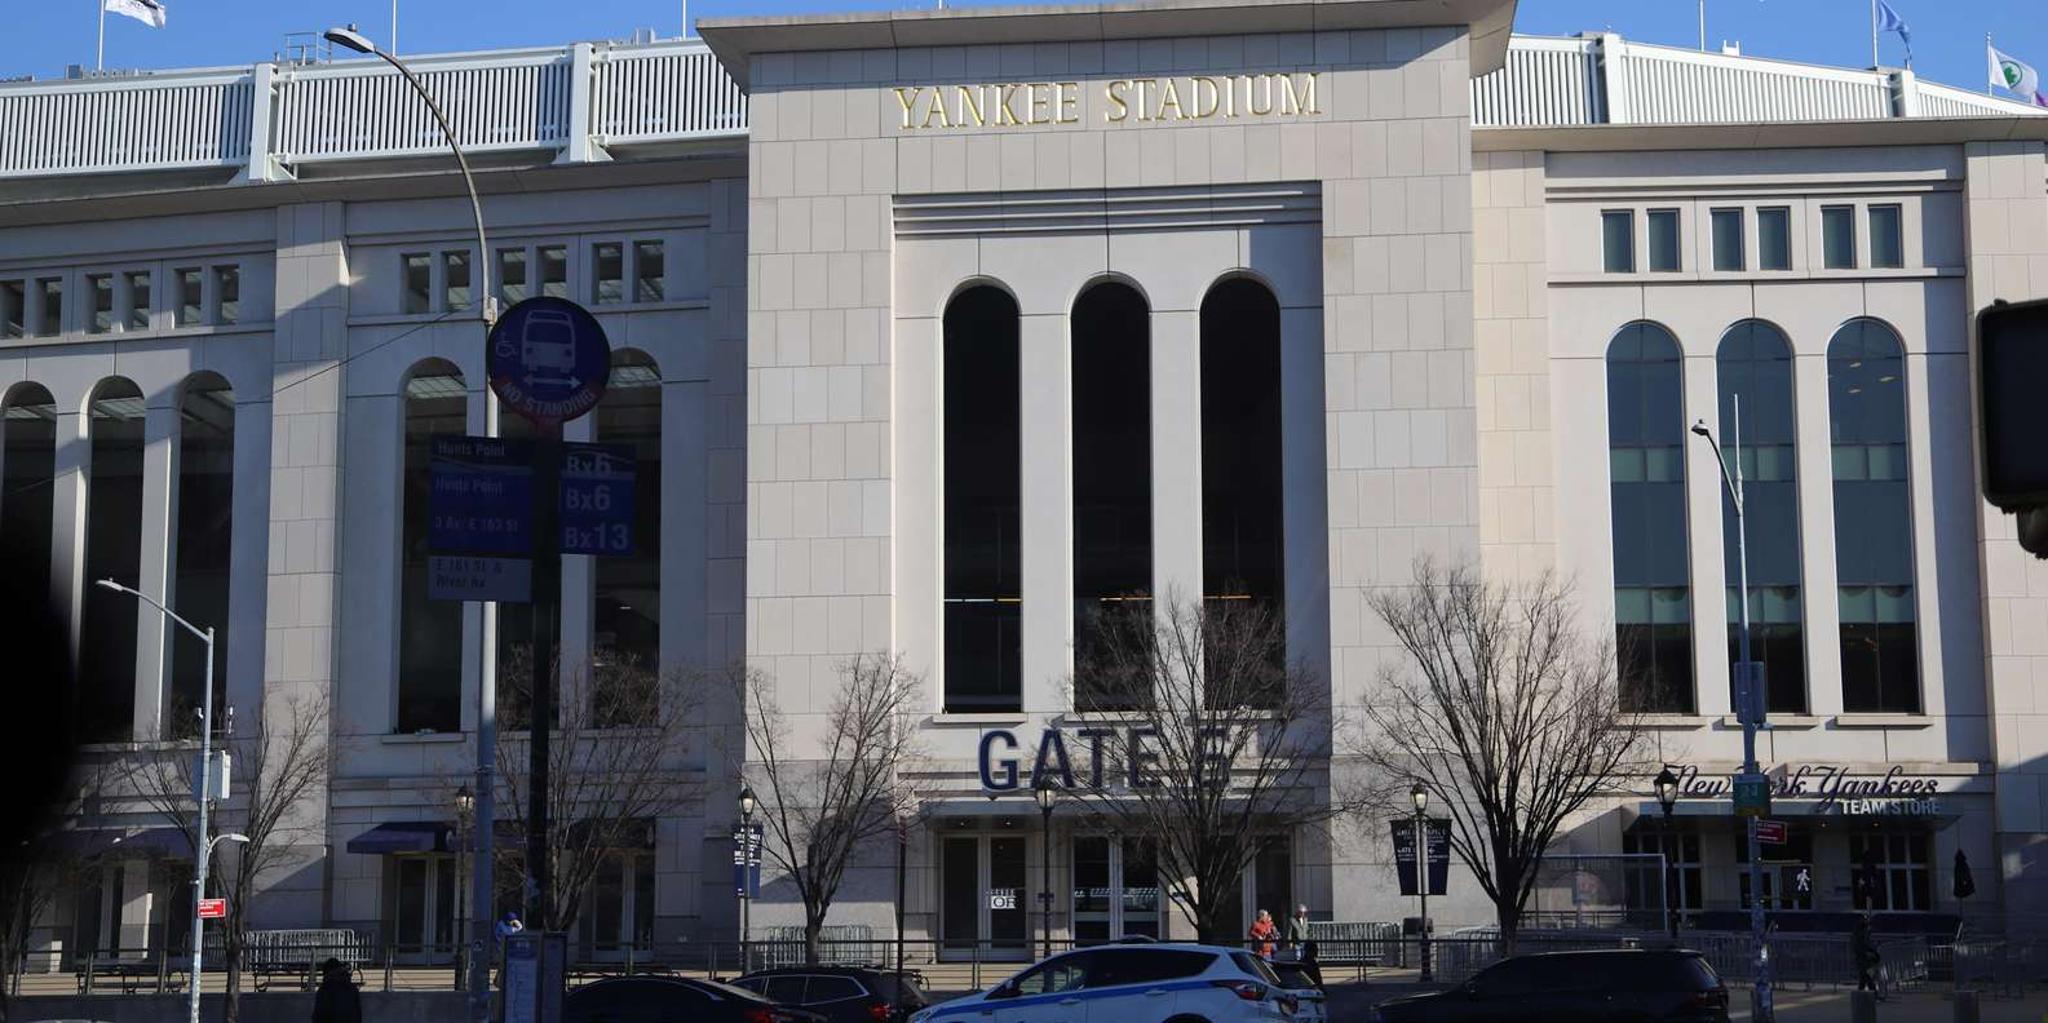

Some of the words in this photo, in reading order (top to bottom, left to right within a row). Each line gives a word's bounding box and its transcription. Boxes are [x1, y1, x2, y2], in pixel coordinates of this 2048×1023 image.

[893, 82, 1079, 129] YANKEE
[1106, 72, 1321, 122] STADIUM
[501, 382, 522, 404] NO
[525, 388, 595, 416] STANDING
[475, 443, 505, 457] Point
[567, 453, 612, 477] Bx6
[473, 478, 503, 496] Point
[566, 485, 611, 511] Bx6
[565, 522, 629, 550] Bx13
[979, 729, 1162, 791] GATE
[1664, 763, 1730, 796] New
[1814, 765, 1938, 813] Yankees
[1840, 800, 1887, 815] TEAM
[1890, 799, 1941, 815] STORE
